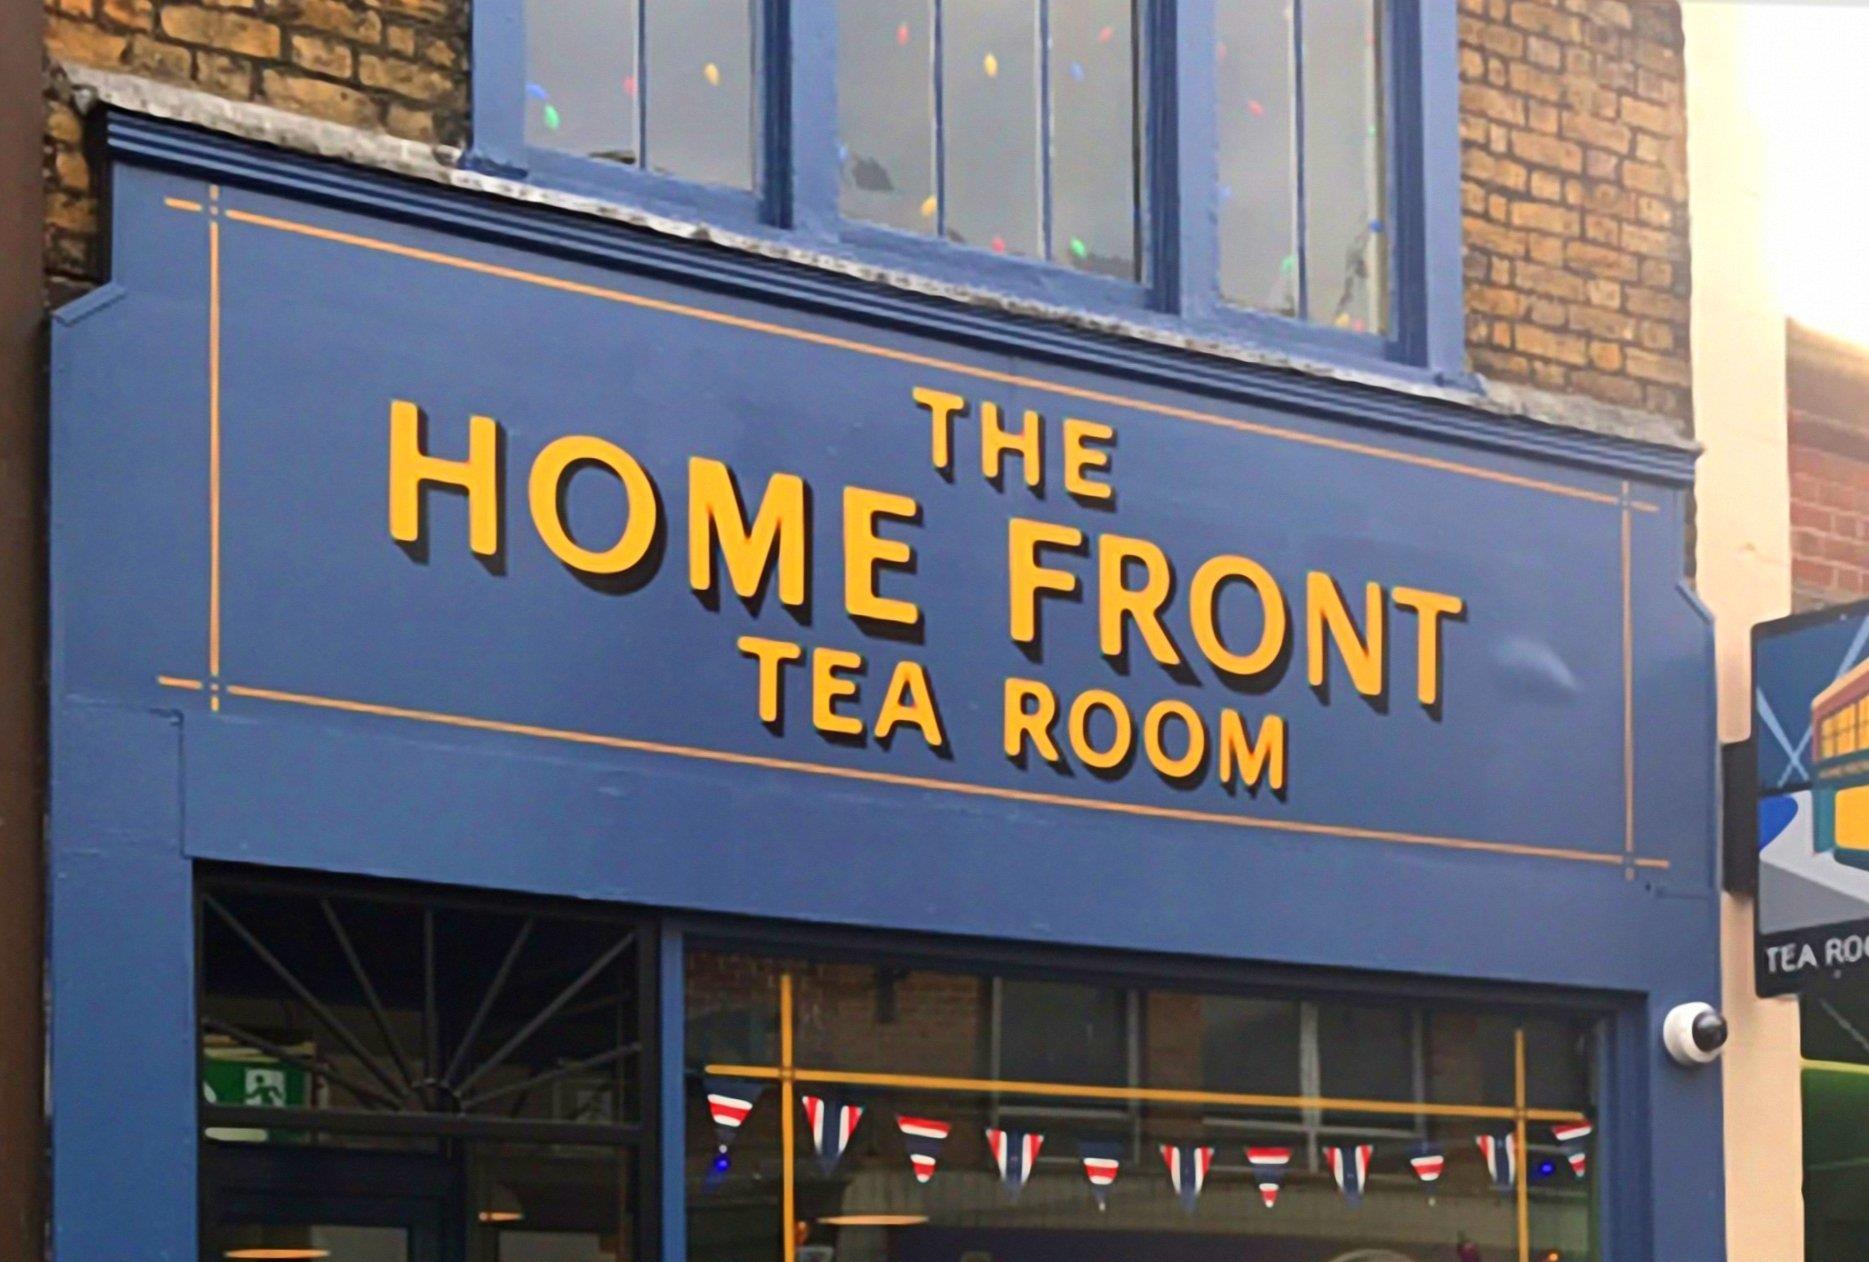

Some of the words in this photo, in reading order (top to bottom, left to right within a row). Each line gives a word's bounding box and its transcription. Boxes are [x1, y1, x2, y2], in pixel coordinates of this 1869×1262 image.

[914, 388, 1114, 506] THE
[388, 401, 921, 631] HOME
[1009, 518, 1464, 710] FRONT
[737, 636, 947, 753] TEA
[1003, 678, 1288, 796] ROOM
[1766, 942, 1818, 974] TEA
[1824, 934, 1869, 966] RO
